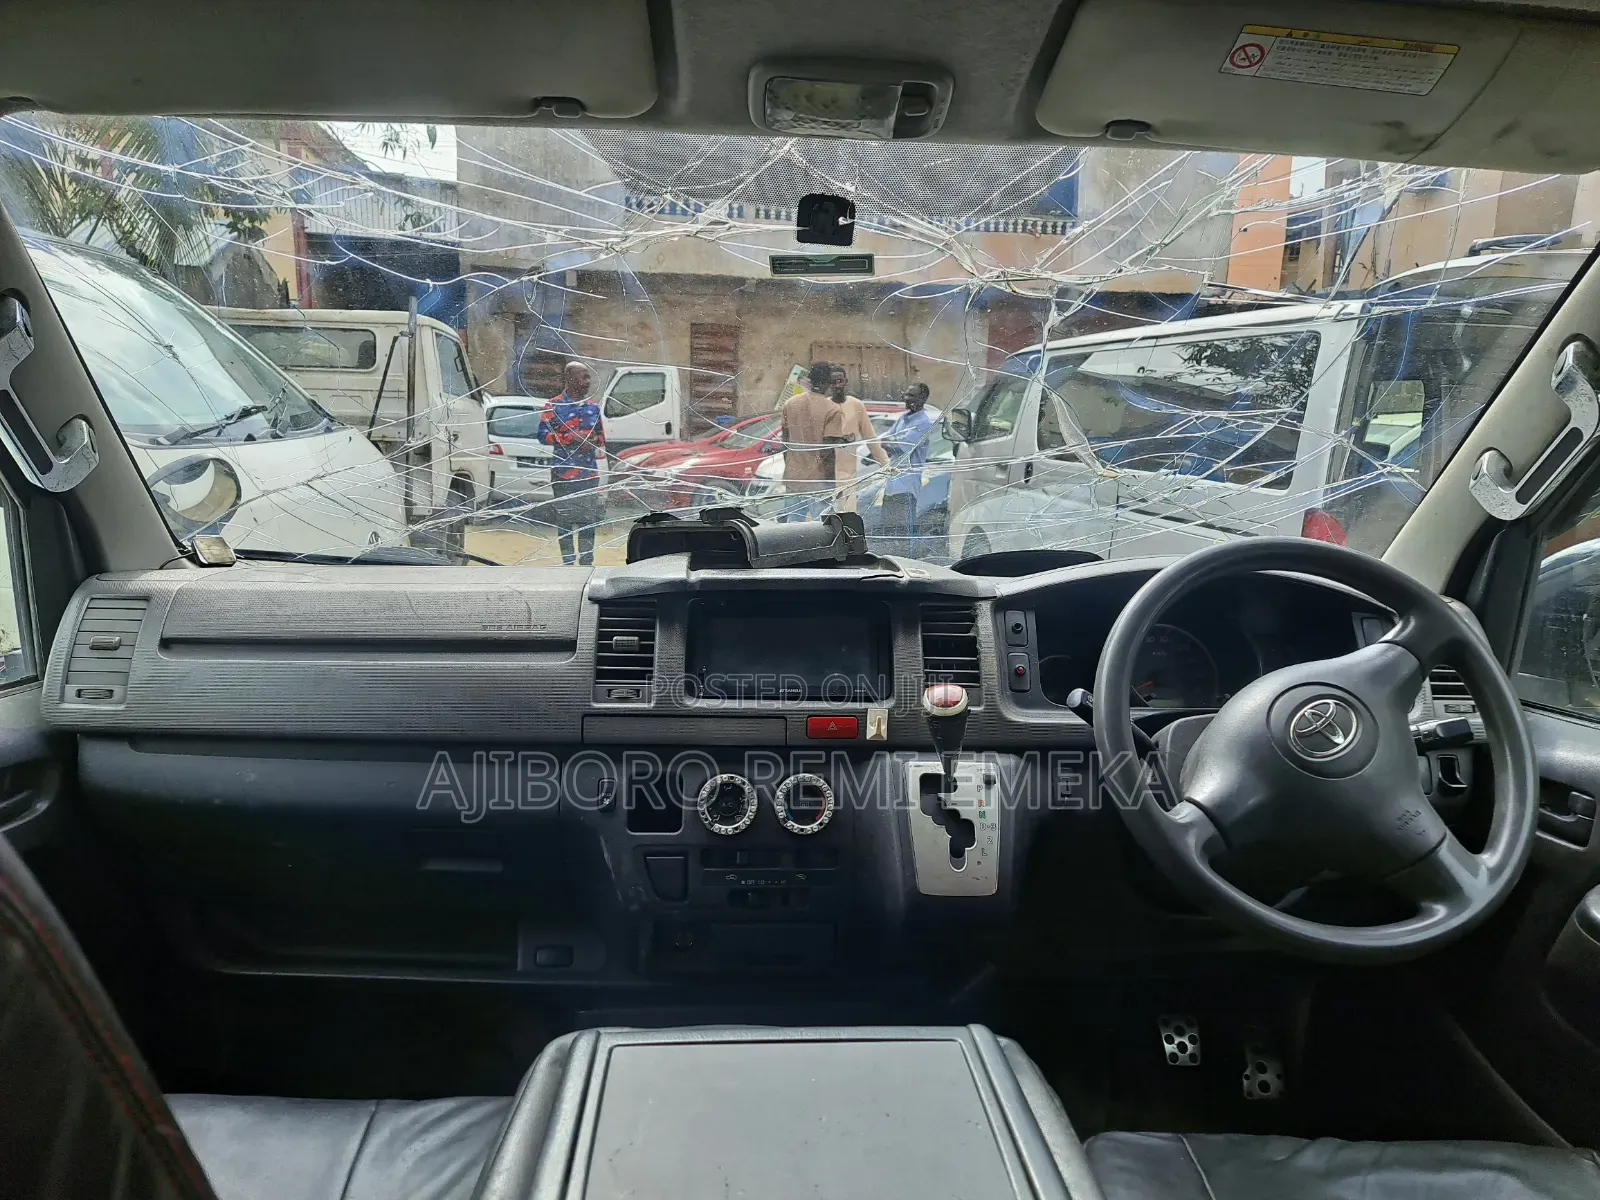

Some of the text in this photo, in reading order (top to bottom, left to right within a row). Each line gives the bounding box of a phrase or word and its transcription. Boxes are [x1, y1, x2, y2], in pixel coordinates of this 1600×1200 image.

[977, 784, 983, 792] P
[977, 799, 985, 807] R
[978, 810, 986, 819] N
[986, 836, 993, 844] 2
